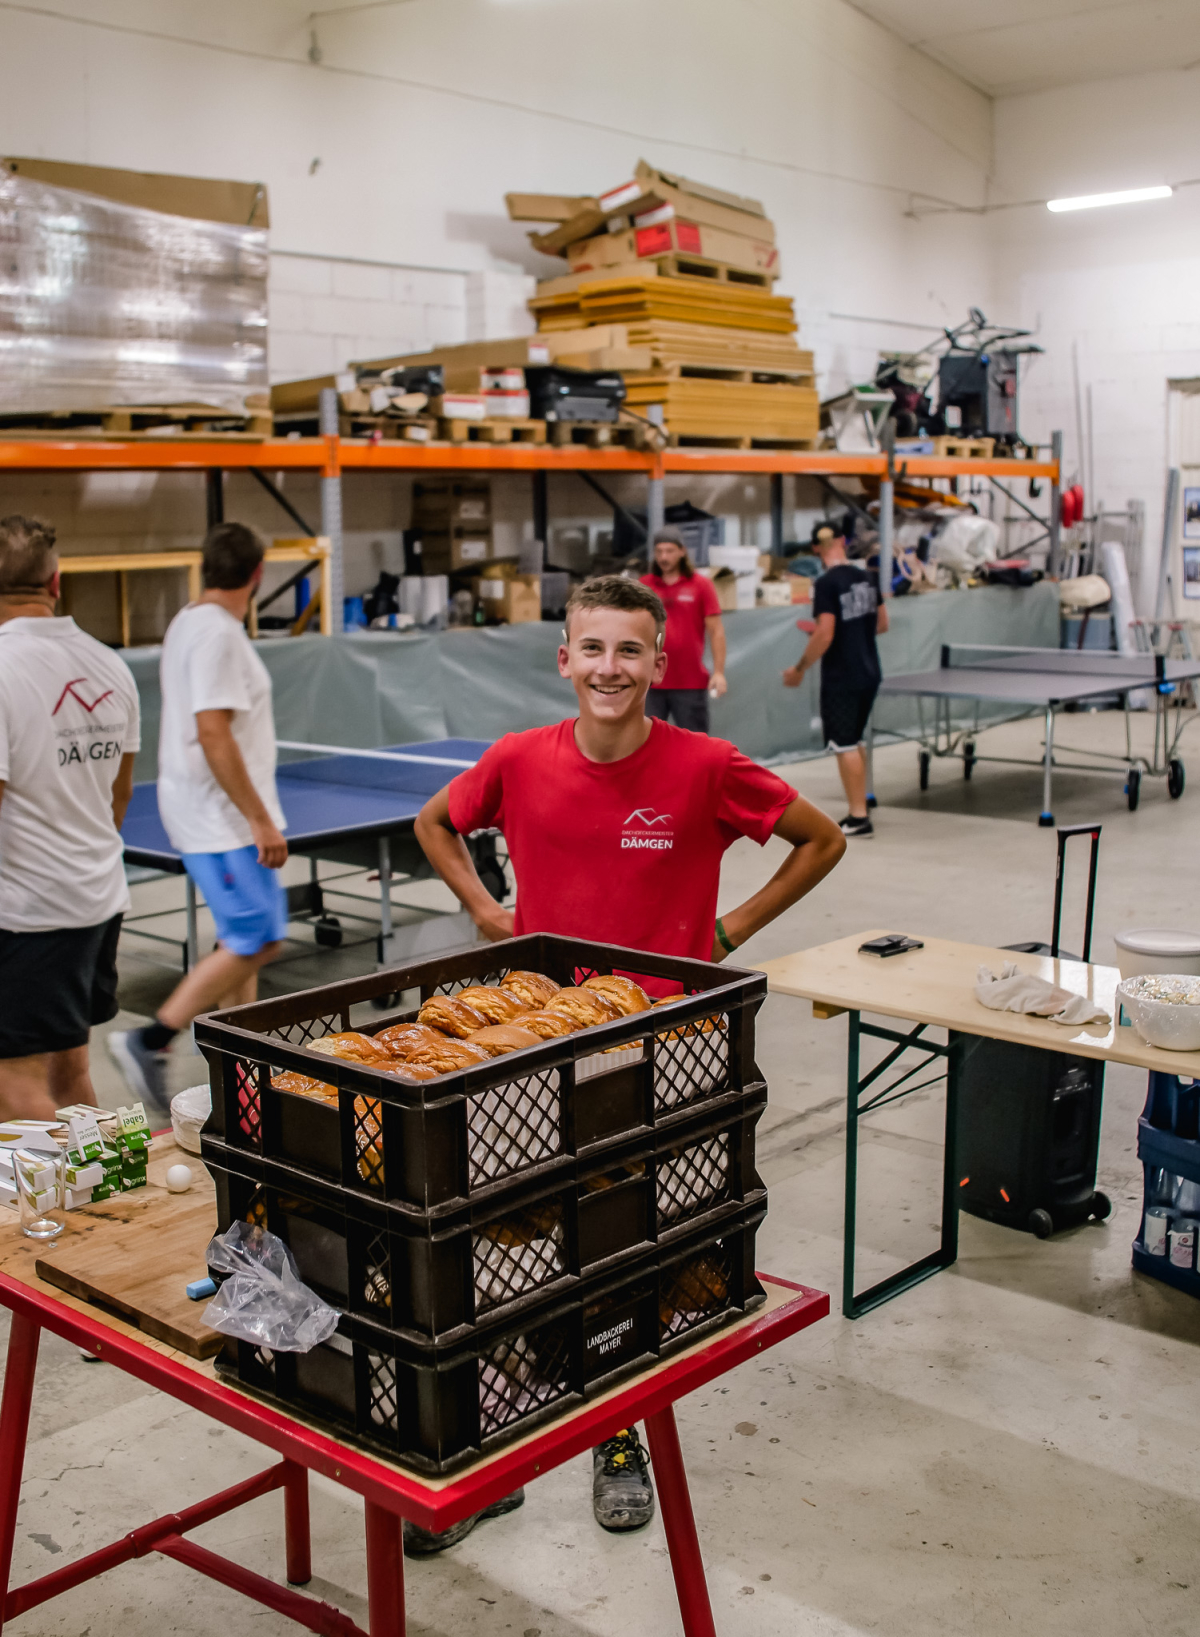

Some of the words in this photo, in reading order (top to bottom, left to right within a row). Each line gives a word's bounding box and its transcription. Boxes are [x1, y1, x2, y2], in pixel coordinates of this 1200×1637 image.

[621, 836, 673, 849] DÄMGEN
[123, 1115, 145, 1127] Gabel
[599, 1336, 621, 1355] MAYER
